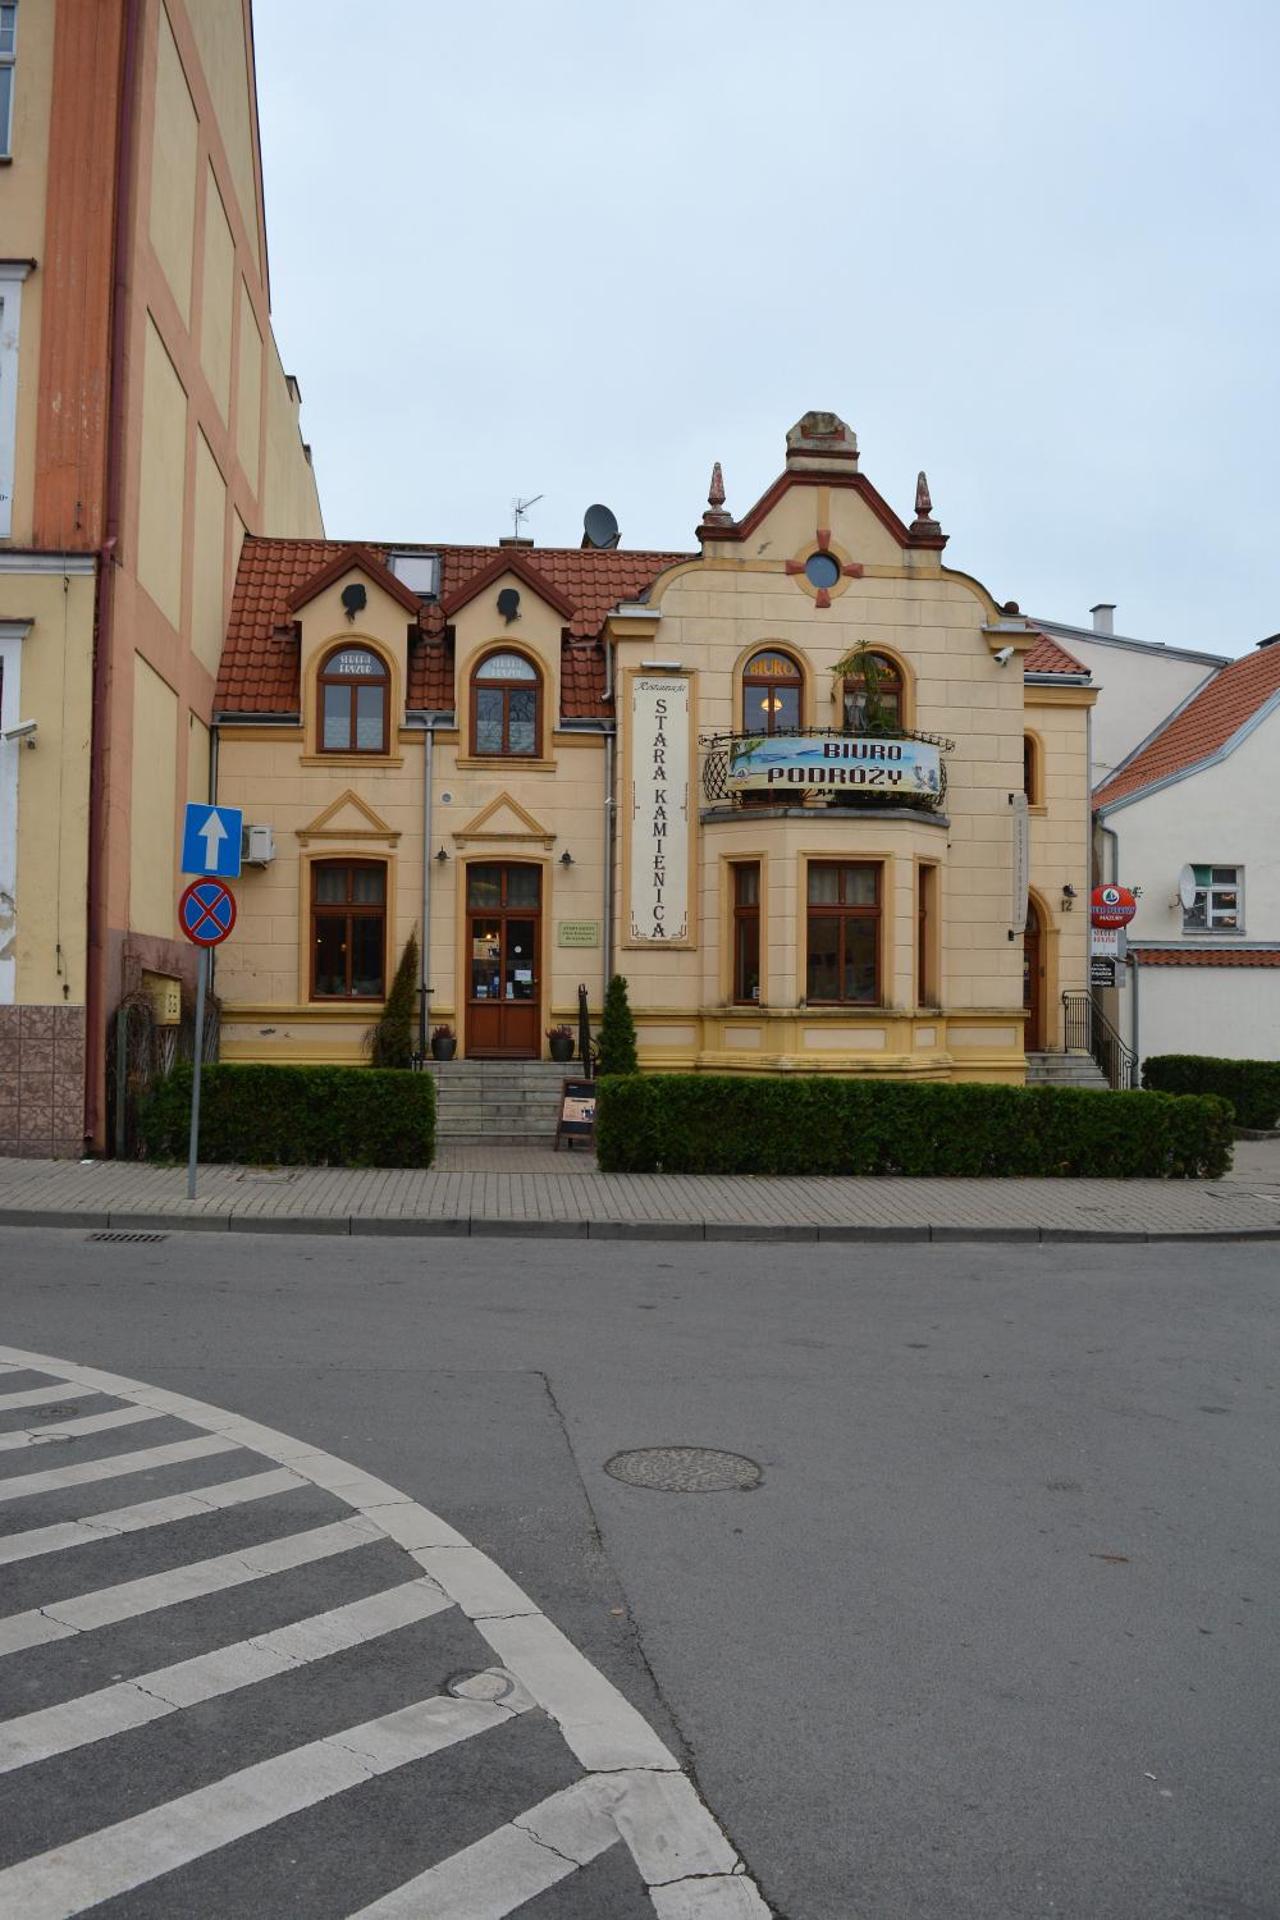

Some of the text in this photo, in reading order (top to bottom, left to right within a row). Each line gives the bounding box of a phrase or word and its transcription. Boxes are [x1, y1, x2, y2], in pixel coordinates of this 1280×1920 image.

[823, 743, 902, 761] BIURO
[767, 764, 902, 785] PODRÓŻY
[651, 698, 668, 938] STARA KAMIENICA
[1061, 900, 1073, 912] 12
